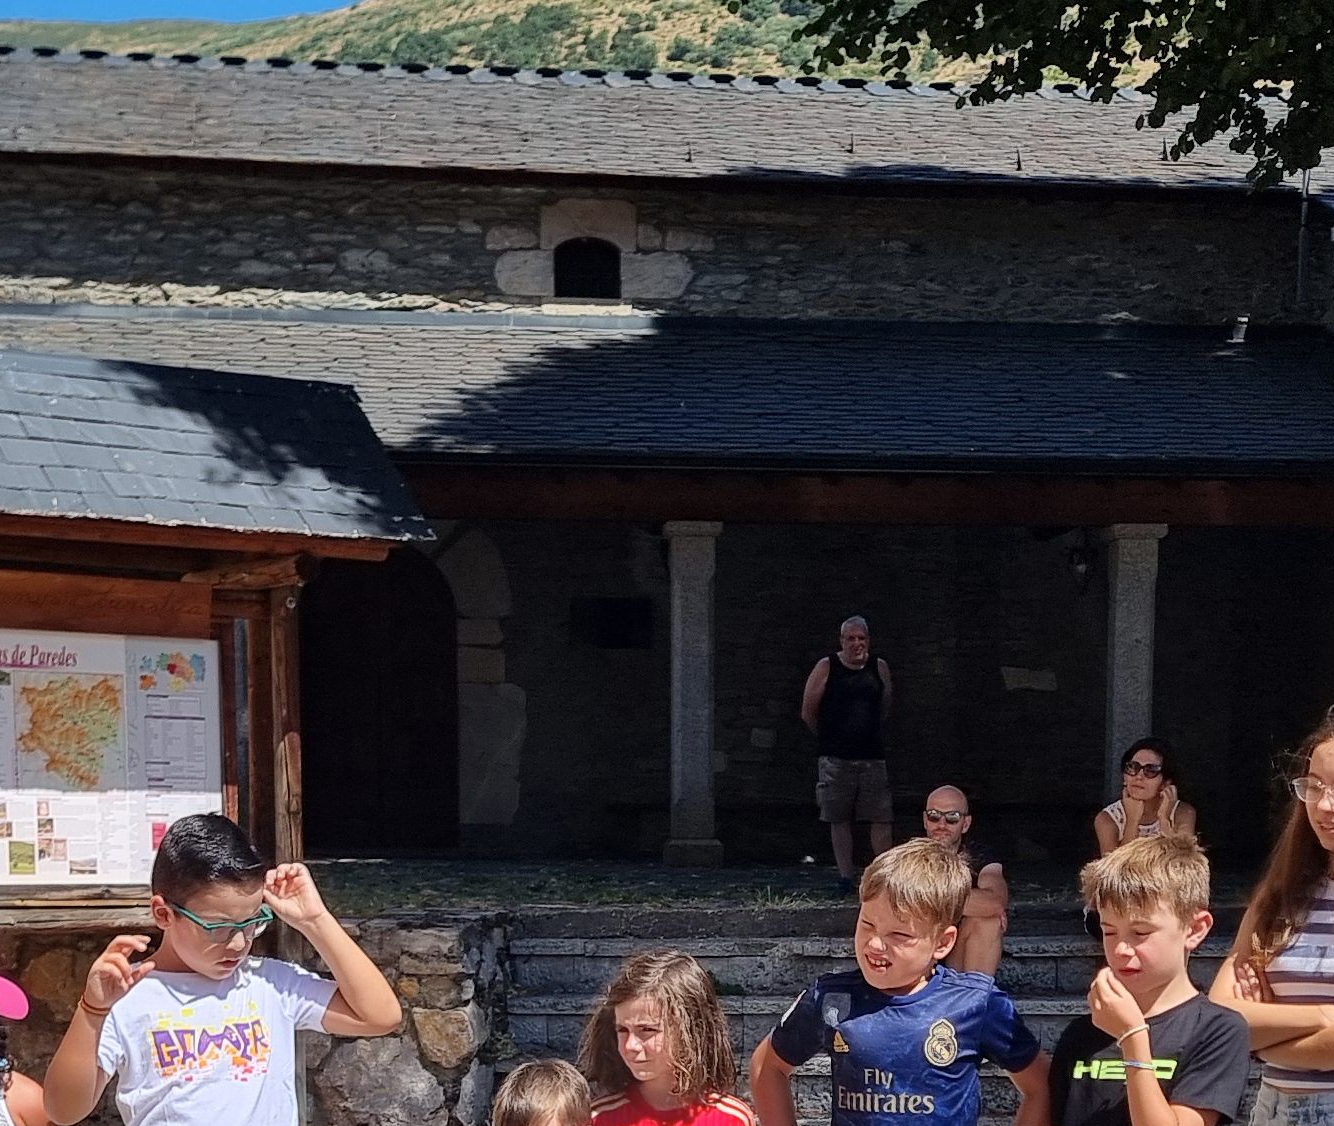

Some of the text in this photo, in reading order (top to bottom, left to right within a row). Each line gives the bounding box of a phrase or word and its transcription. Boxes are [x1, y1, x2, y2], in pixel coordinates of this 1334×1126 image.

[11, 643, 27, 665] de
[29, 645, 78, 667] Paredes
[864, 1068, 893, 1089] Fly
[1073, 1060, 1178, 1080] HED
[838, 1086, 936, 1114] Emirates
